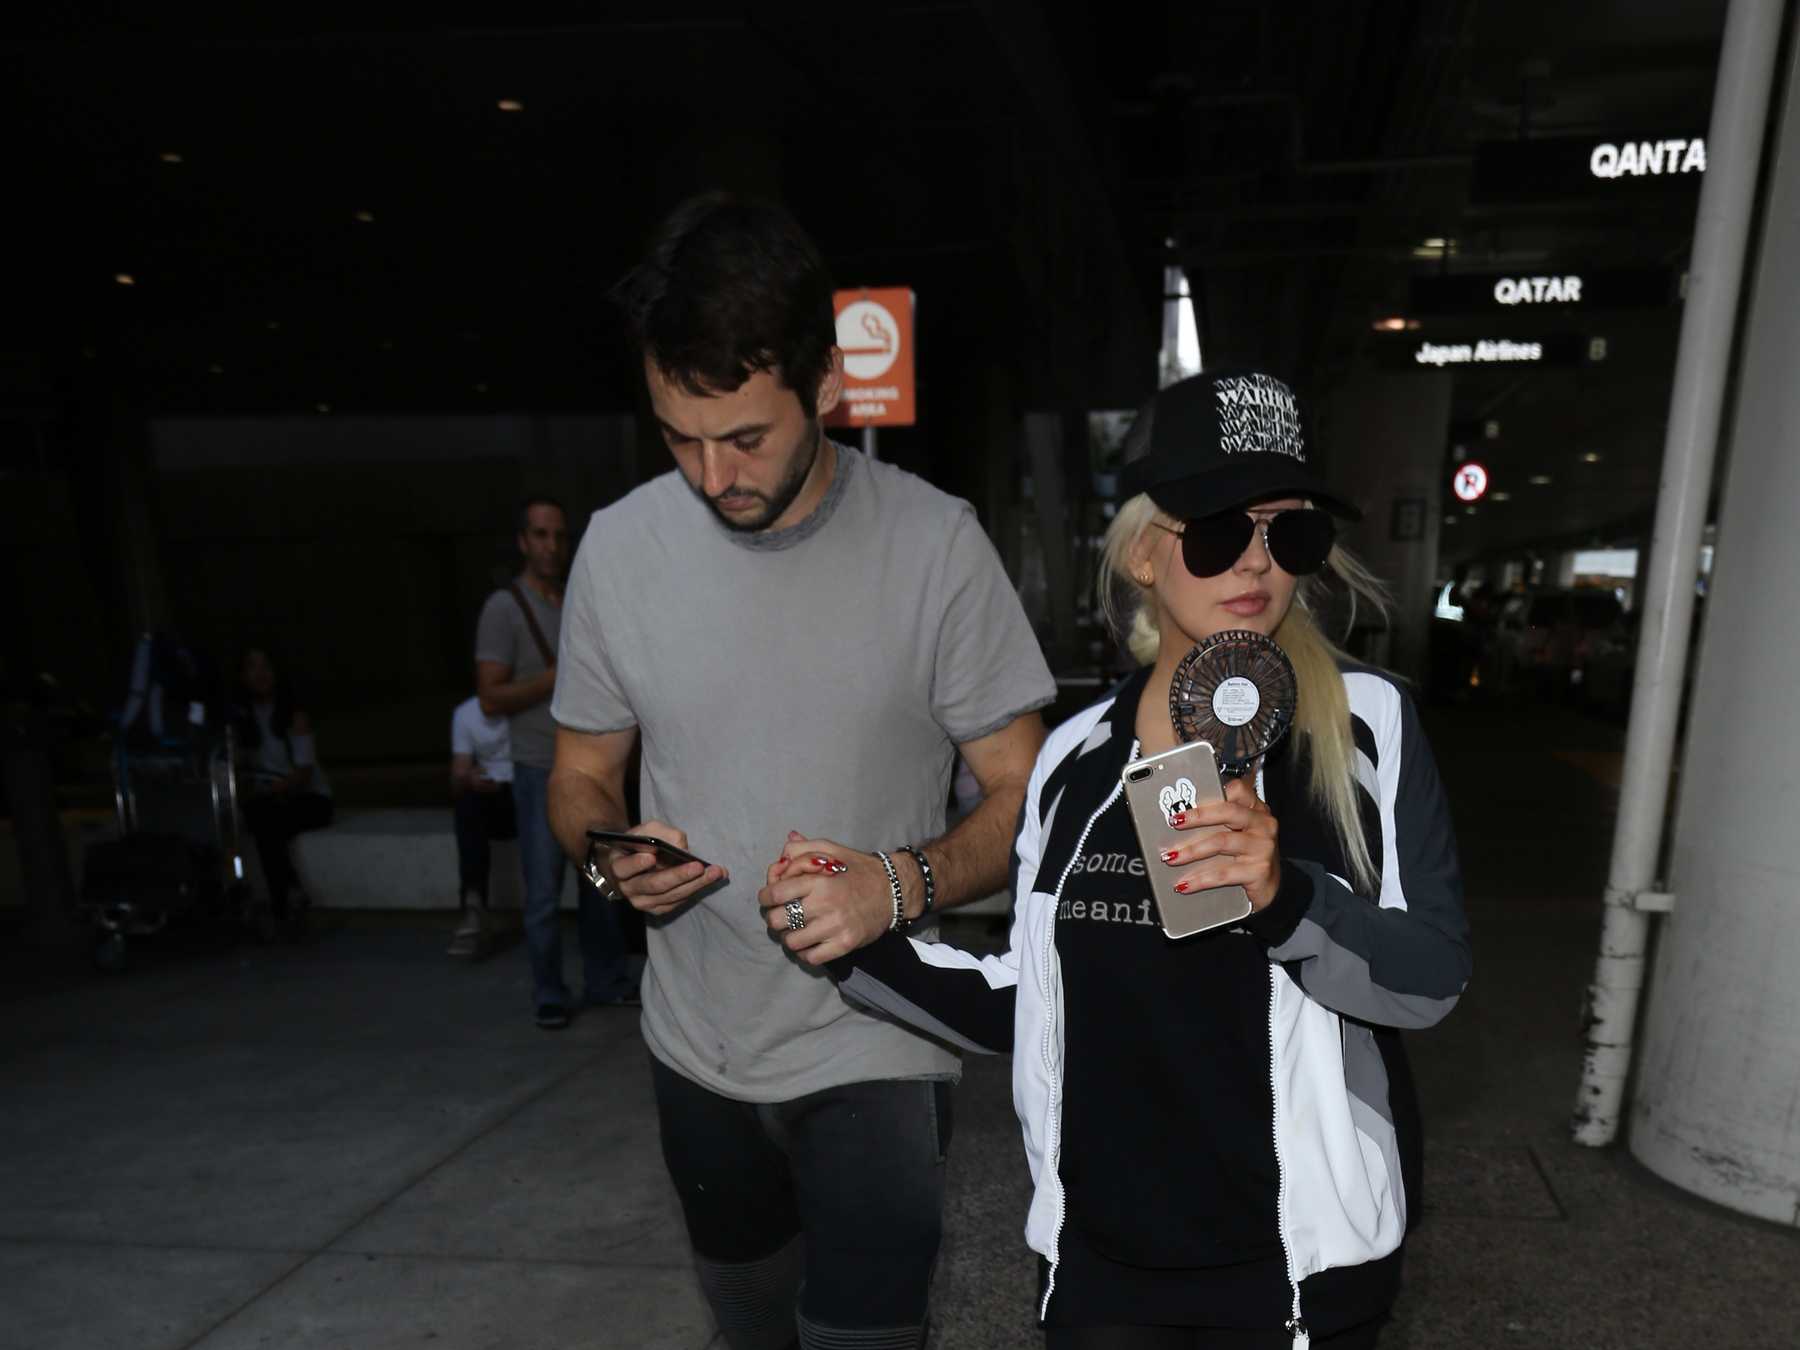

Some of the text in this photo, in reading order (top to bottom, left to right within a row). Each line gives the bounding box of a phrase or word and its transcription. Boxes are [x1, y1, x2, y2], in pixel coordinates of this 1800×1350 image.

[1494, 276, 1583, 305] QATAR
[1415, 339, 1543, 367] Japan Airlines
[1060, 899, 1161, 926] meani
